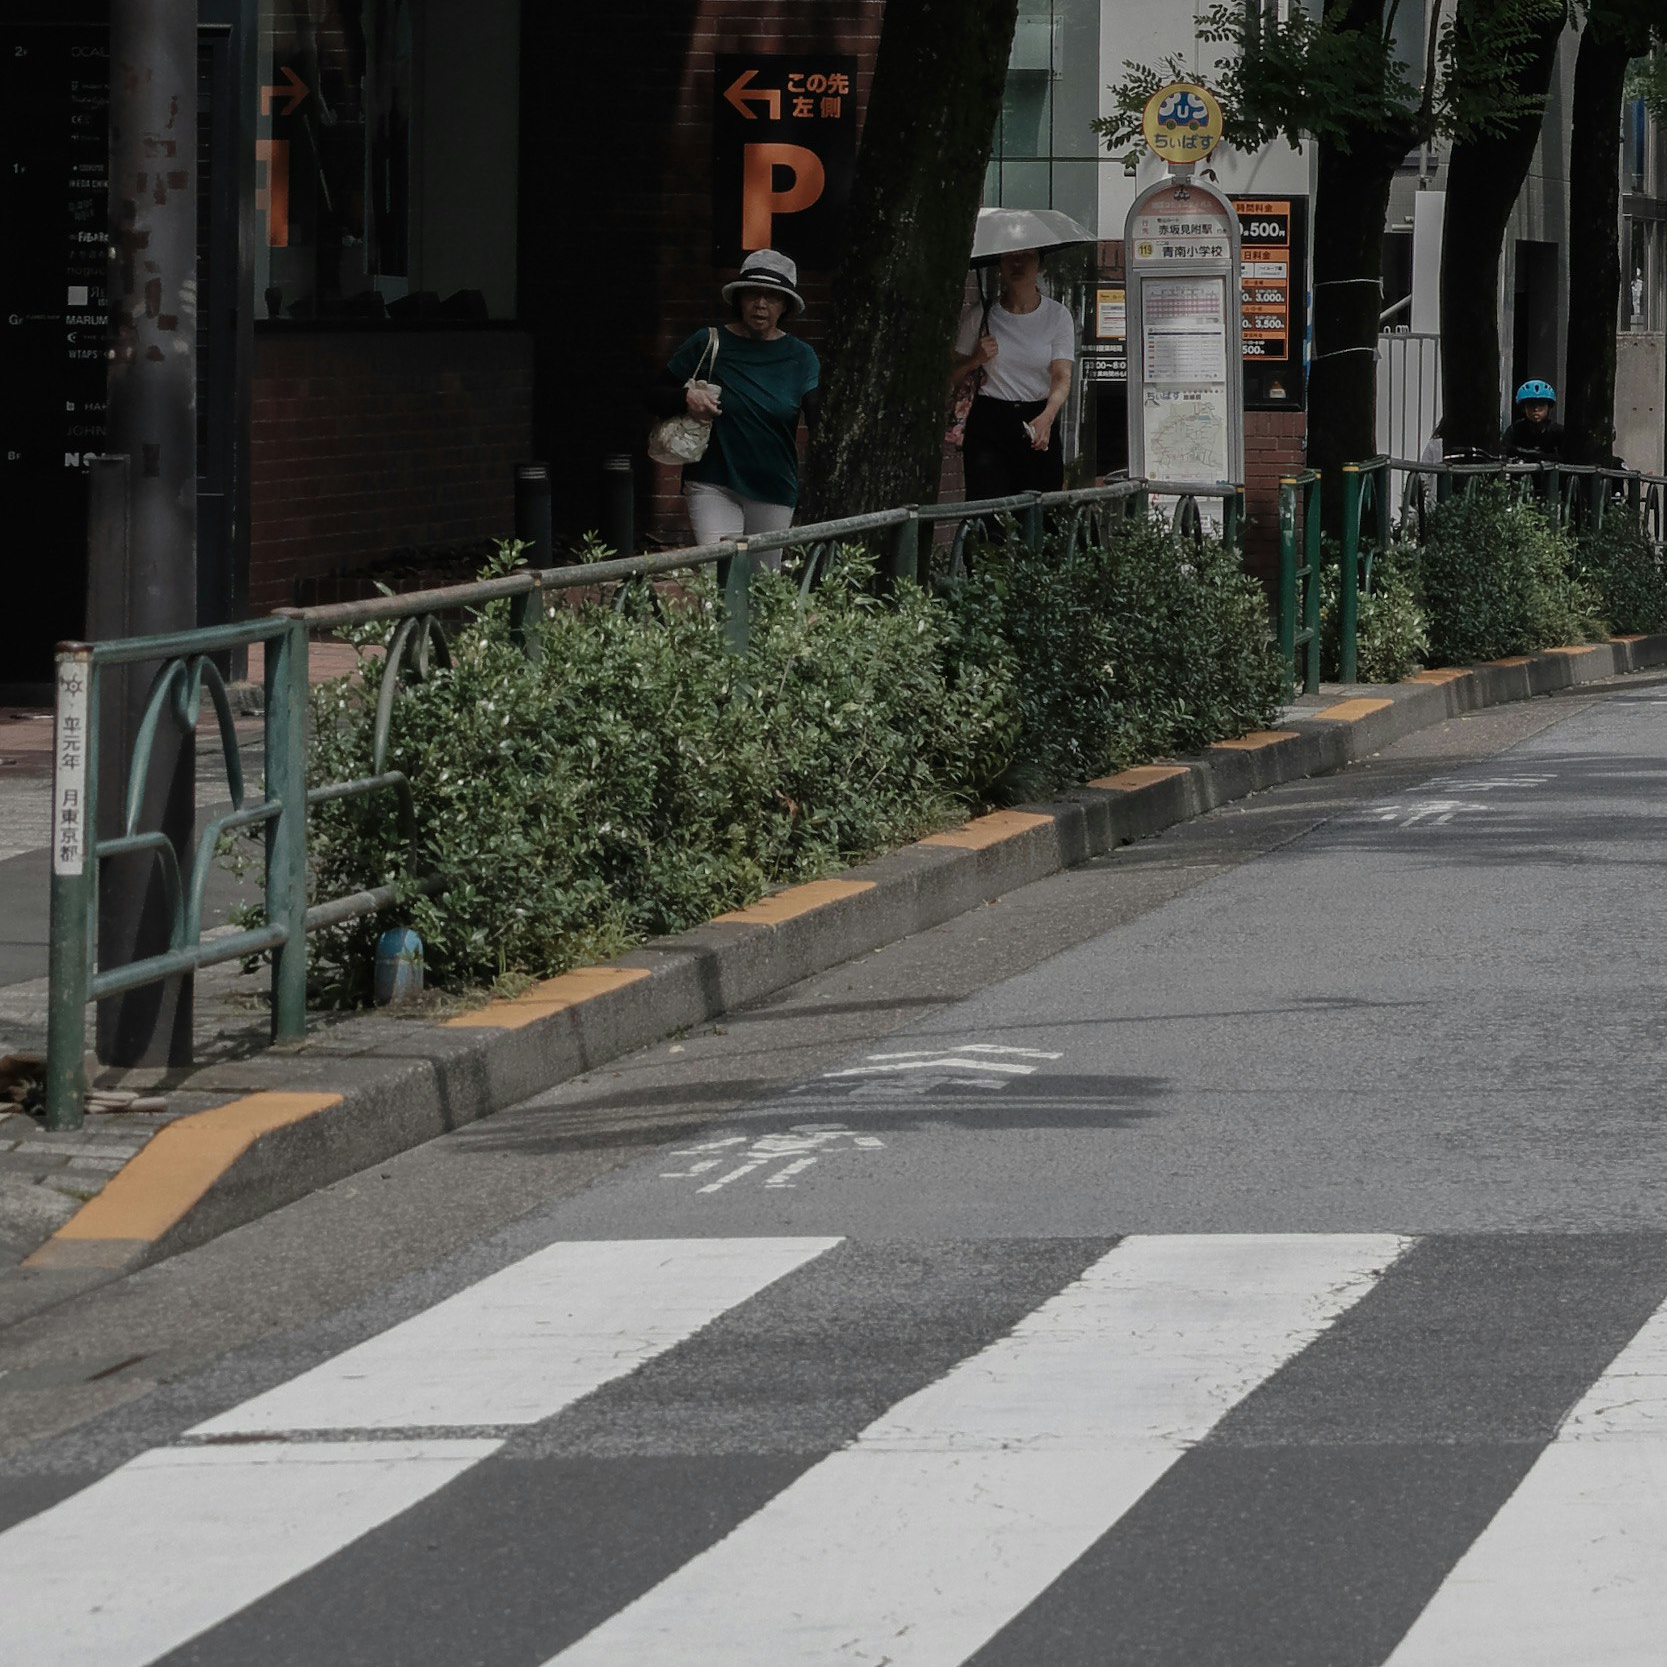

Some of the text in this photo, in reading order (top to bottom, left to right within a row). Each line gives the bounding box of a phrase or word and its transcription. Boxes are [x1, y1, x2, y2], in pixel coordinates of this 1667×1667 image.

[786, 73, 849, 95] この先
[792, 96, 842, 119] 左側
[742, 143, 825, 251] P
[1158, 223, 1213, 235] 赤坂見附駅
[1163, 245, 1223, 257] 青南小学校
